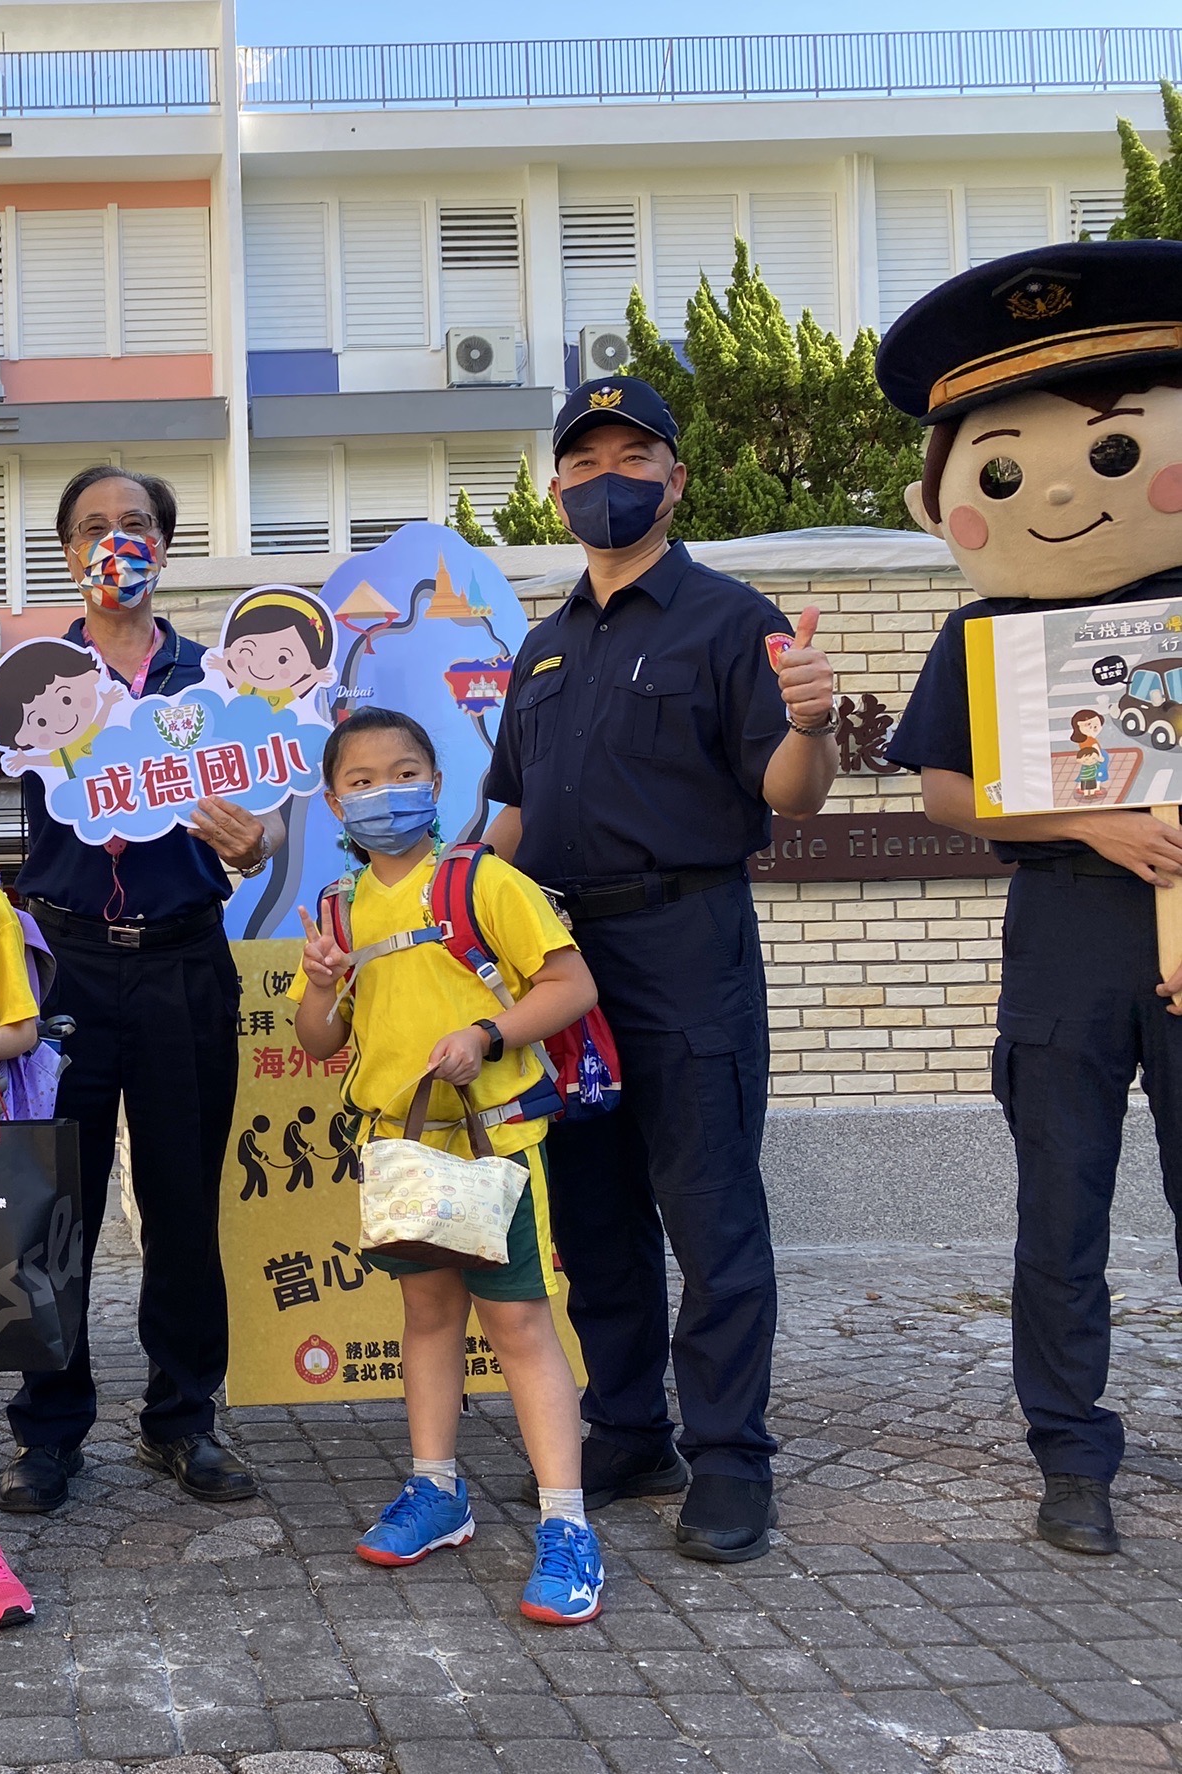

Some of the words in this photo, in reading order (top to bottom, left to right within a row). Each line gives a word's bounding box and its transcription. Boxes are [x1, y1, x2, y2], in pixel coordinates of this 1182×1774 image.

[169, 718, 194, 732] 成德
[335, 685, 374, 698] Dubai
[835, 693, 901, 773] 德
[86, 736, 308, 820] 成德國小
[263, 1240, 399, 1312] 當心
